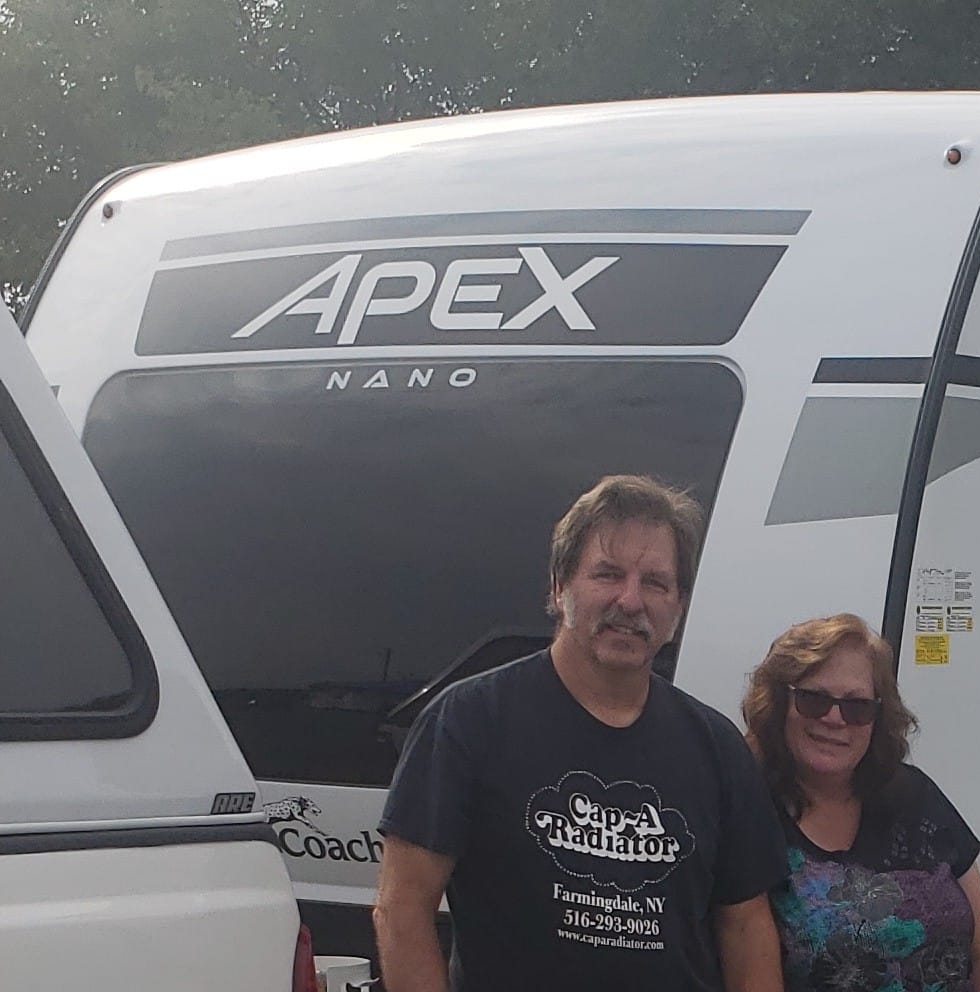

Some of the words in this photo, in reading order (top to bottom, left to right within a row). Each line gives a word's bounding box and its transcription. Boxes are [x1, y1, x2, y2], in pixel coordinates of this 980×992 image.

[231, 246, 620, 345] APEX
[326, 368, 478, 390] NANO
[535, 810, 680, 862] Radiator
[553, 883, 643, 915] Farmingdale,
[646, 897, 666, 914] NY
[563, 909, 660, 936] 516-293-9026
[558, 928, 664, 950] www.caparadiator.com
